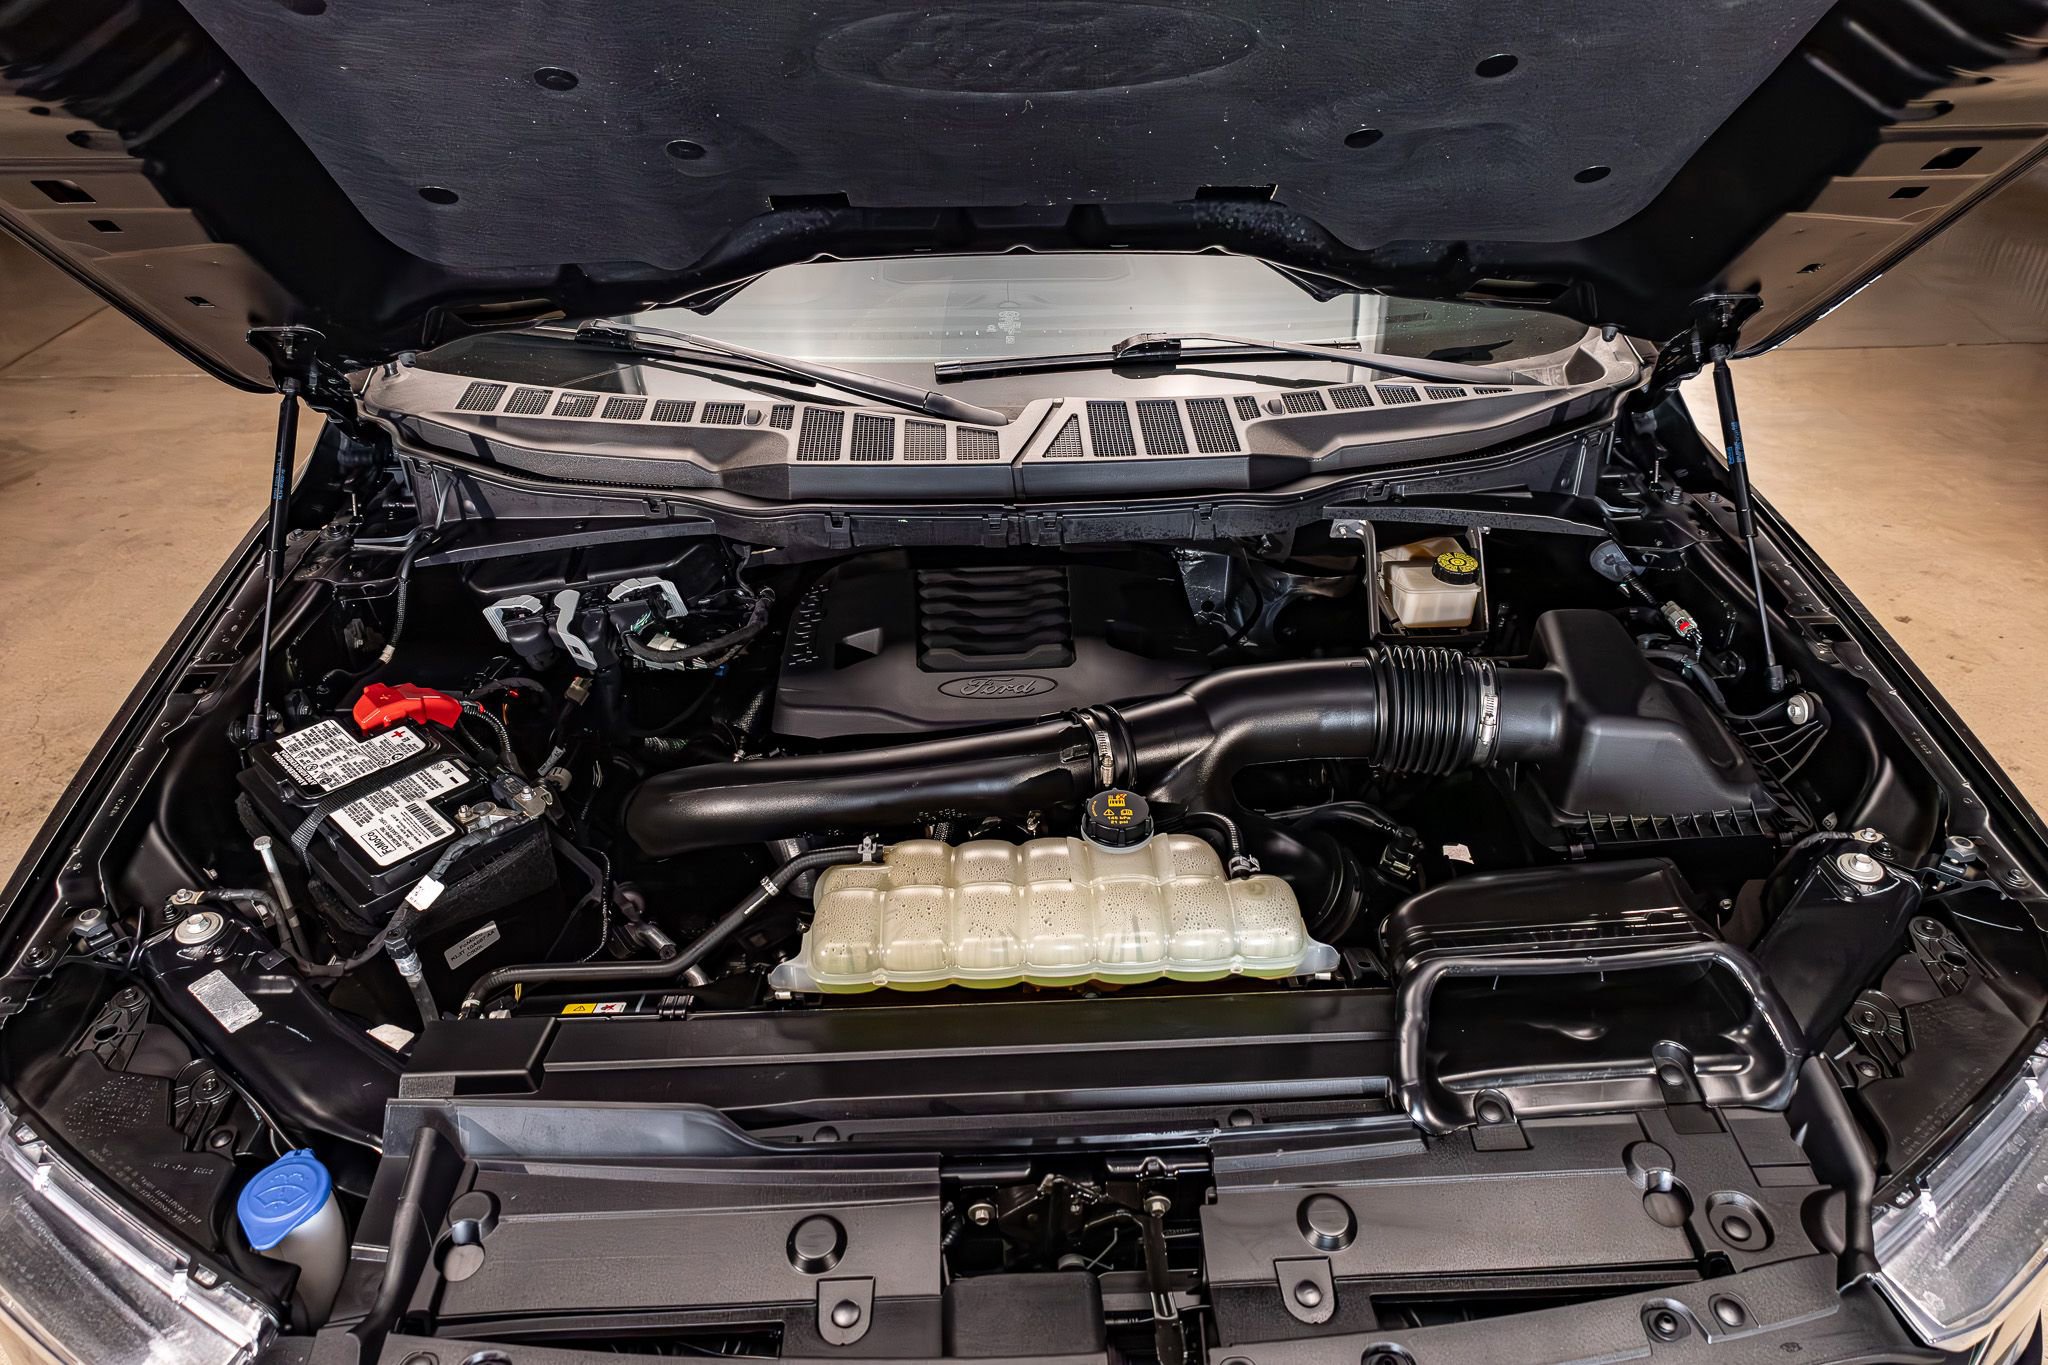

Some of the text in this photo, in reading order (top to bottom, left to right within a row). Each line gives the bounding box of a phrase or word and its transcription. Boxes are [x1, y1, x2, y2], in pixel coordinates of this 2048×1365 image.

[960, 678, 1037, 696] Ford
[367, 831, 392, 855] FoMoCo
[459, 933, 482, 949] FoMoCo
